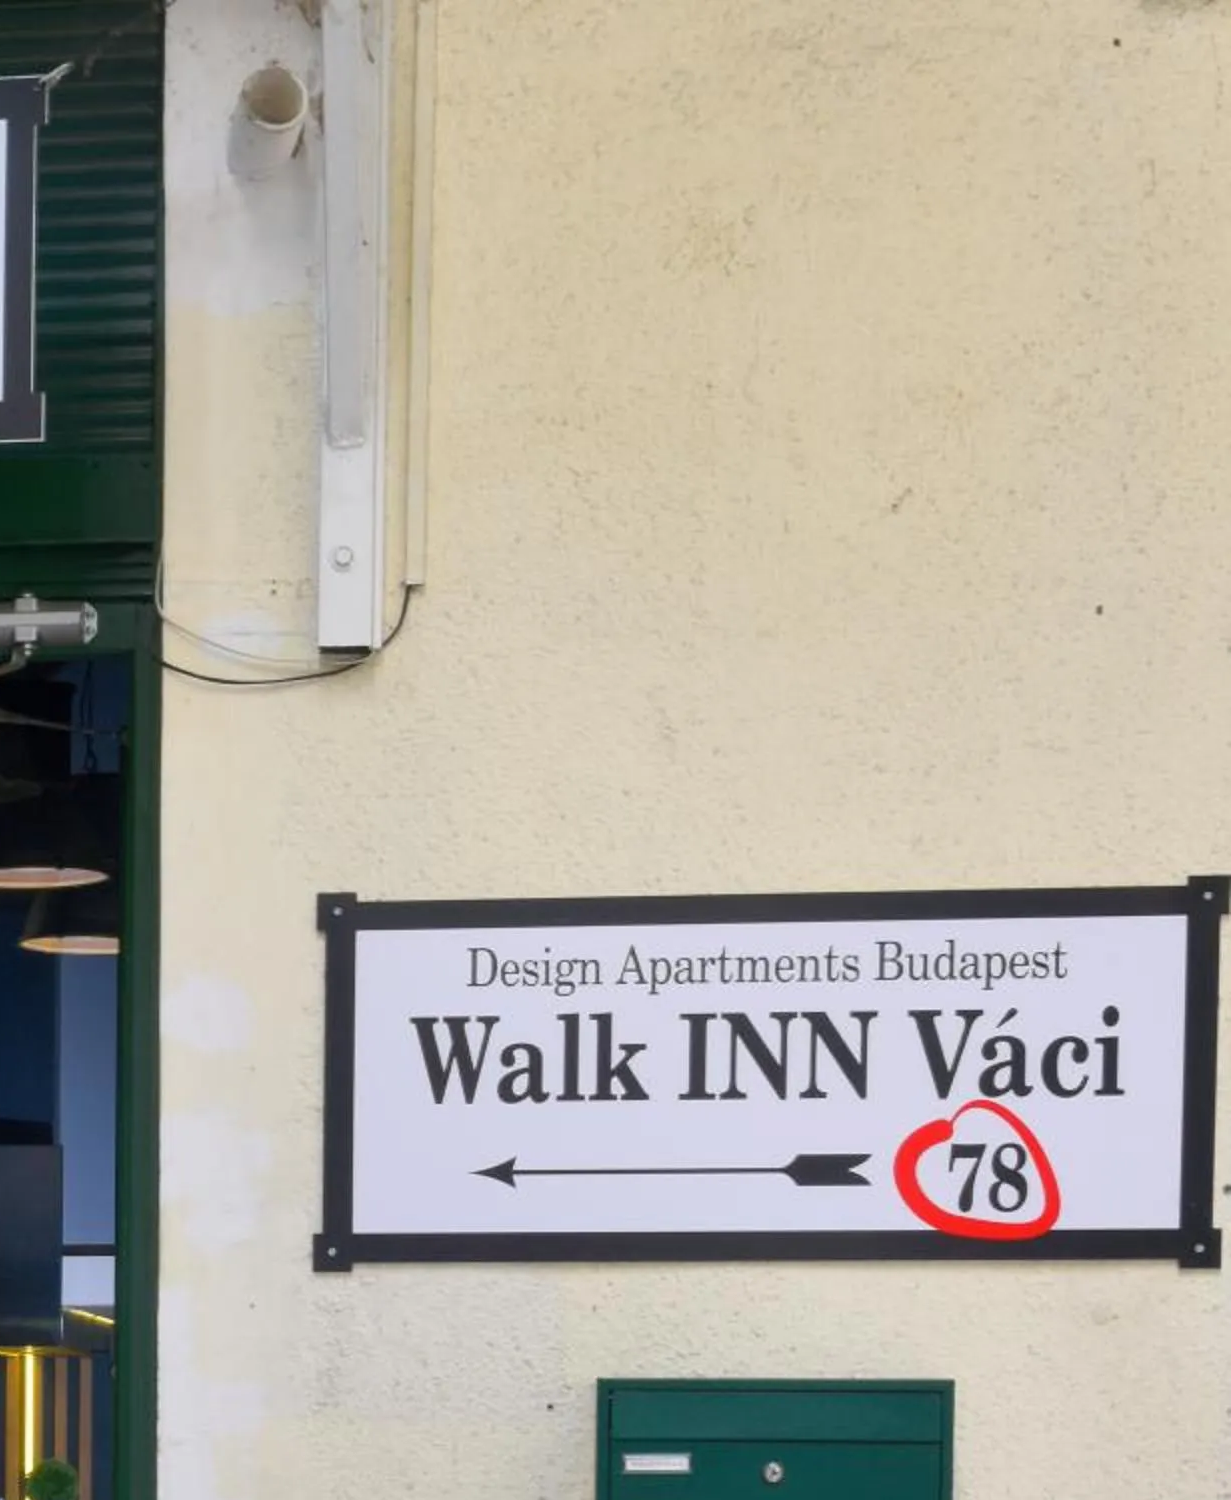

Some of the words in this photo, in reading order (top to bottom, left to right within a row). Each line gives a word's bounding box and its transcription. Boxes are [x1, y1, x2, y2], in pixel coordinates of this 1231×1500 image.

[467, 948, 602, 996] Design
[616, 946, 859, 995] Apartments
[875, 940, 1067, 990] Budapest
[410, 1013, 649, 1104] Walk
[679, 1011, 878, 1100] INN
[908, 1006, 1124, 1099] Váci
[949, 1143, 1027, 1212] 78
